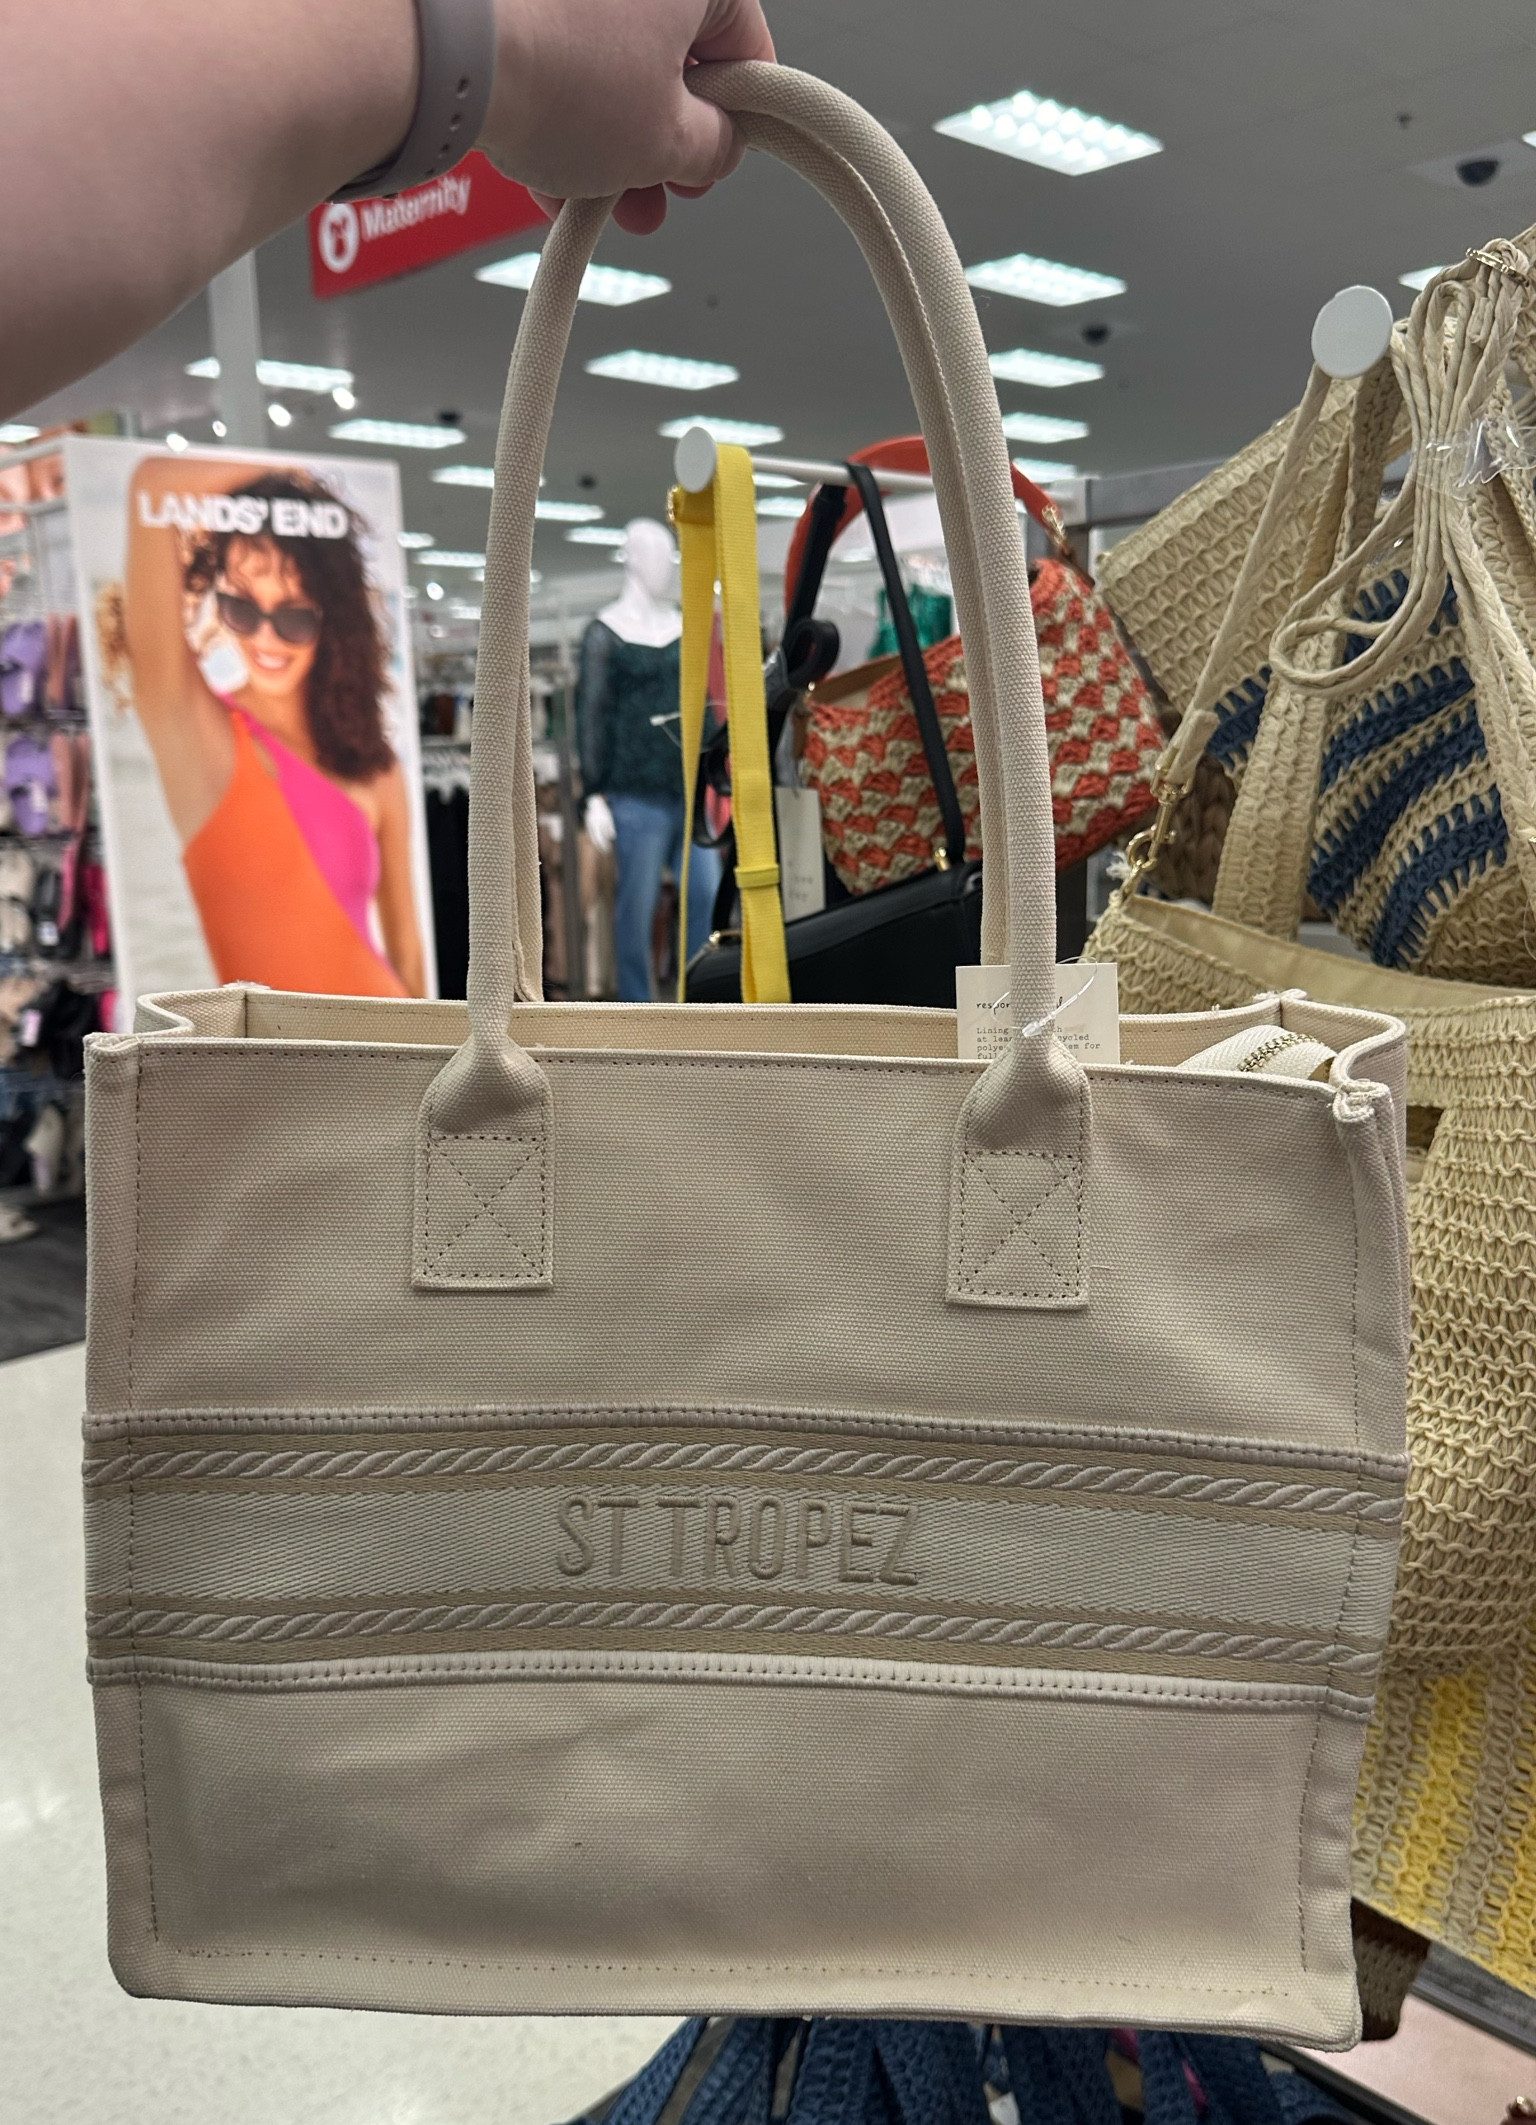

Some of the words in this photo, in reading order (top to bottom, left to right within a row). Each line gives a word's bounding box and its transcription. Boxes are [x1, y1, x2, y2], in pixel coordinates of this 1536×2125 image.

[361, 174, 471, 242] Maternity
[138, 491, 269, 535] LANDS'
[271, 497, 349, 539] END
[976, 1027, 1009, 1035] Lining
[1084, 1042, 1101, 1050] for
[556, 1493, 639, 1578] ST
[657, 1494, 919, 1586] TROPEZ
